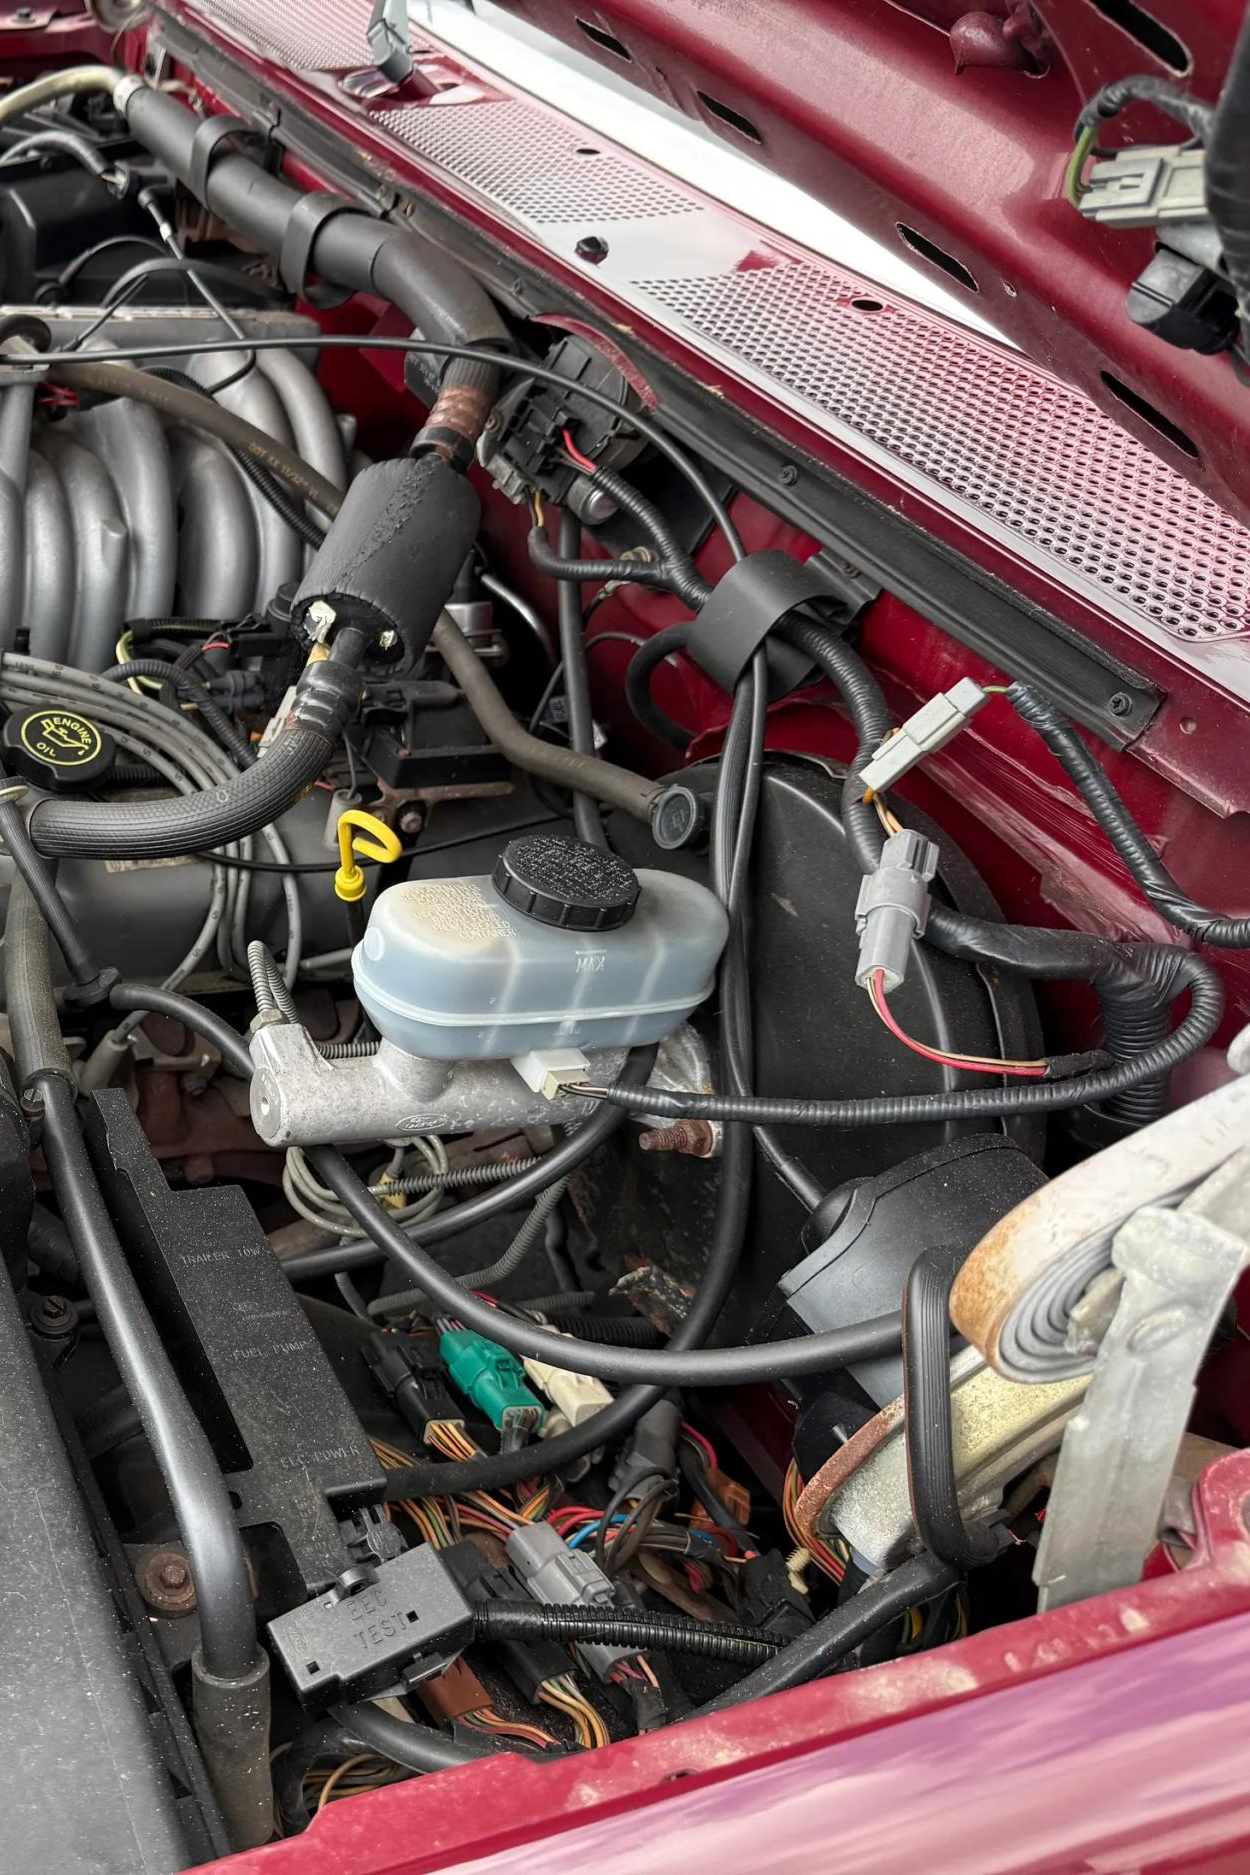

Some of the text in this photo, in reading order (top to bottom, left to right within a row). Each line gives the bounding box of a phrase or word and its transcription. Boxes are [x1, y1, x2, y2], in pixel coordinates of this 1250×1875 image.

[53, 717, 91, 744] ENGINE
[36, 742, 57, 757] OIL
[470, 914, 501, 922] FLUID
[182, 1246, 264, 1265] TRAILER TOW
[233, 1346, 264, 1361] FUEL
[346, 1589, 388, 1624] EEC
[352, 1611, 407, 1649] TEST
